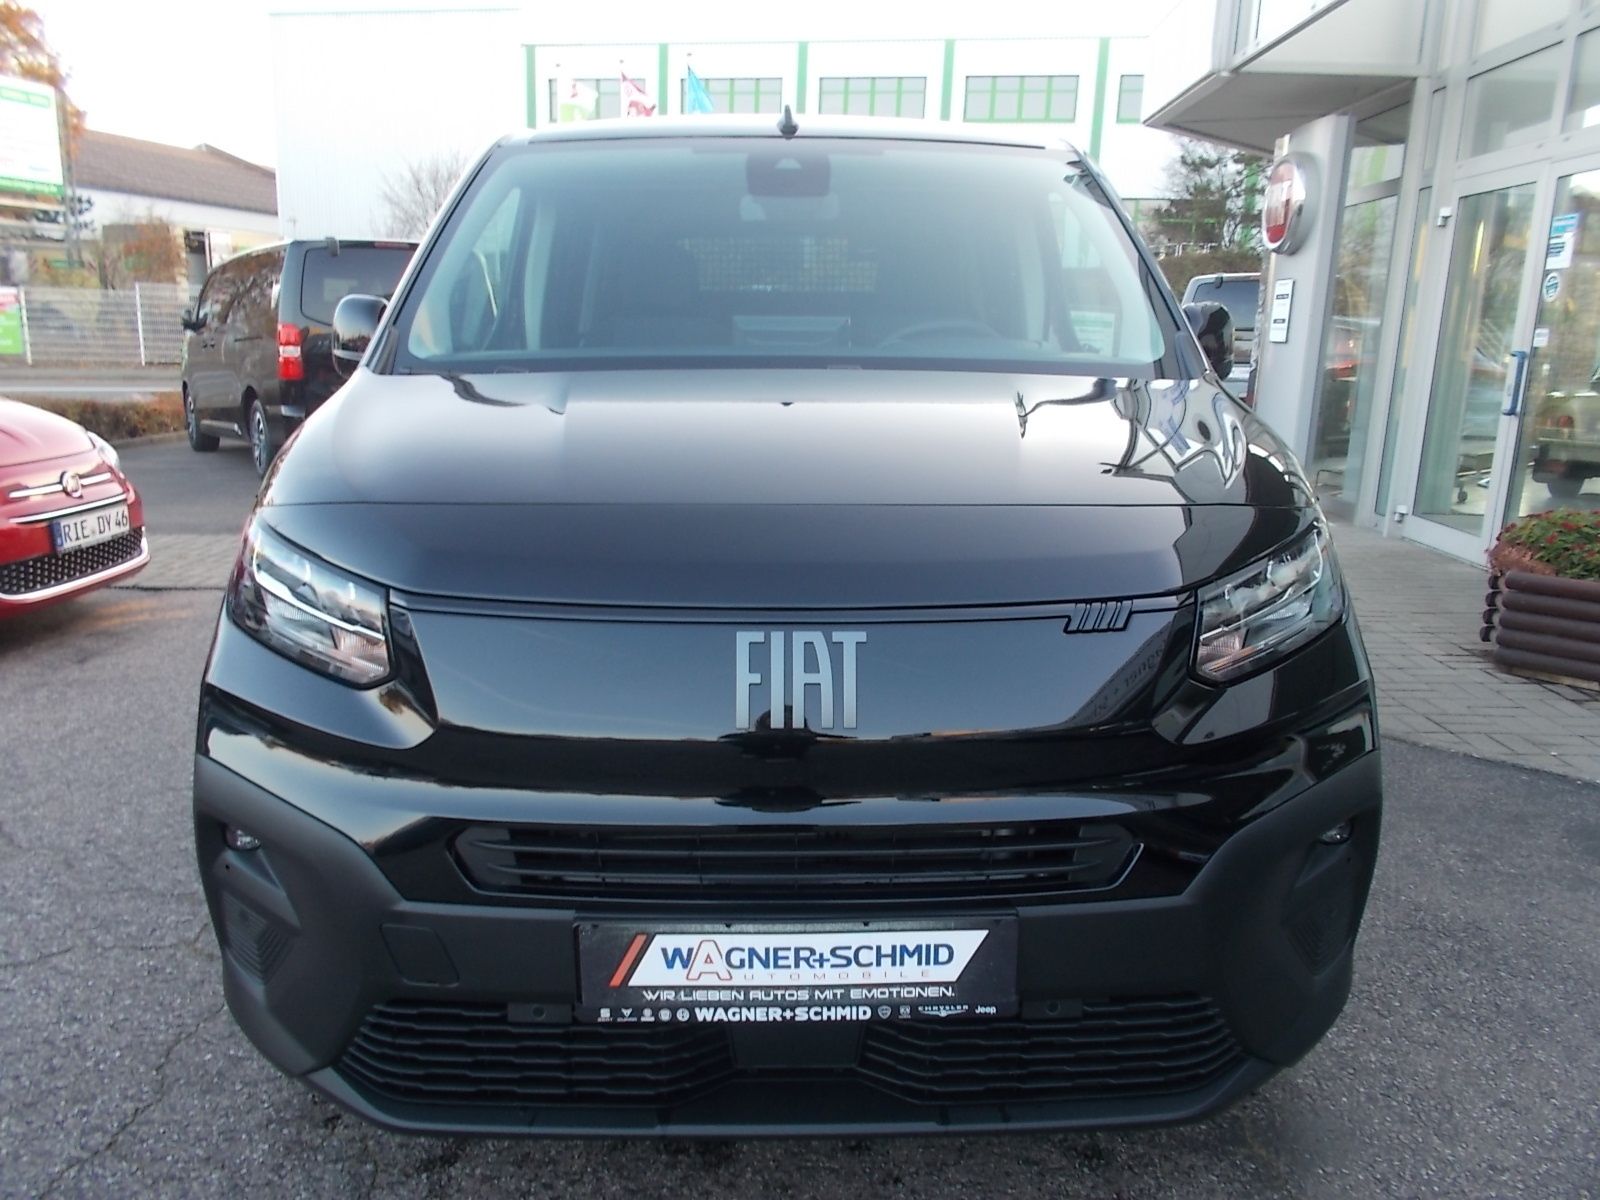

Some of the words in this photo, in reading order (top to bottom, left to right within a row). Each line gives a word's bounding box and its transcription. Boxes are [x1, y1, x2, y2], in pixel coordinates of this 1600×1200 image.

[62, 519, 90, 543] RIE
[97, 513, 112, 535] DY
[114, 509, 129, 529] 46
[735, 631, 867, 729] FIAT
[661, 939, 955, 981] WAGNER+SCHMID
[642, 989, 676, 1001] WIR
[681, 989, 744, 1001] LIEBEN
[750, 989, 810, 1001] AUTOS
[815, 988, 845, 1000] MIT
[850, 985, 955, 999] EMOTIONEN.
[694, 1005, 872, 1022] WAGNER+SCHMID
[975, 1005, 997, 1016] Jeep
